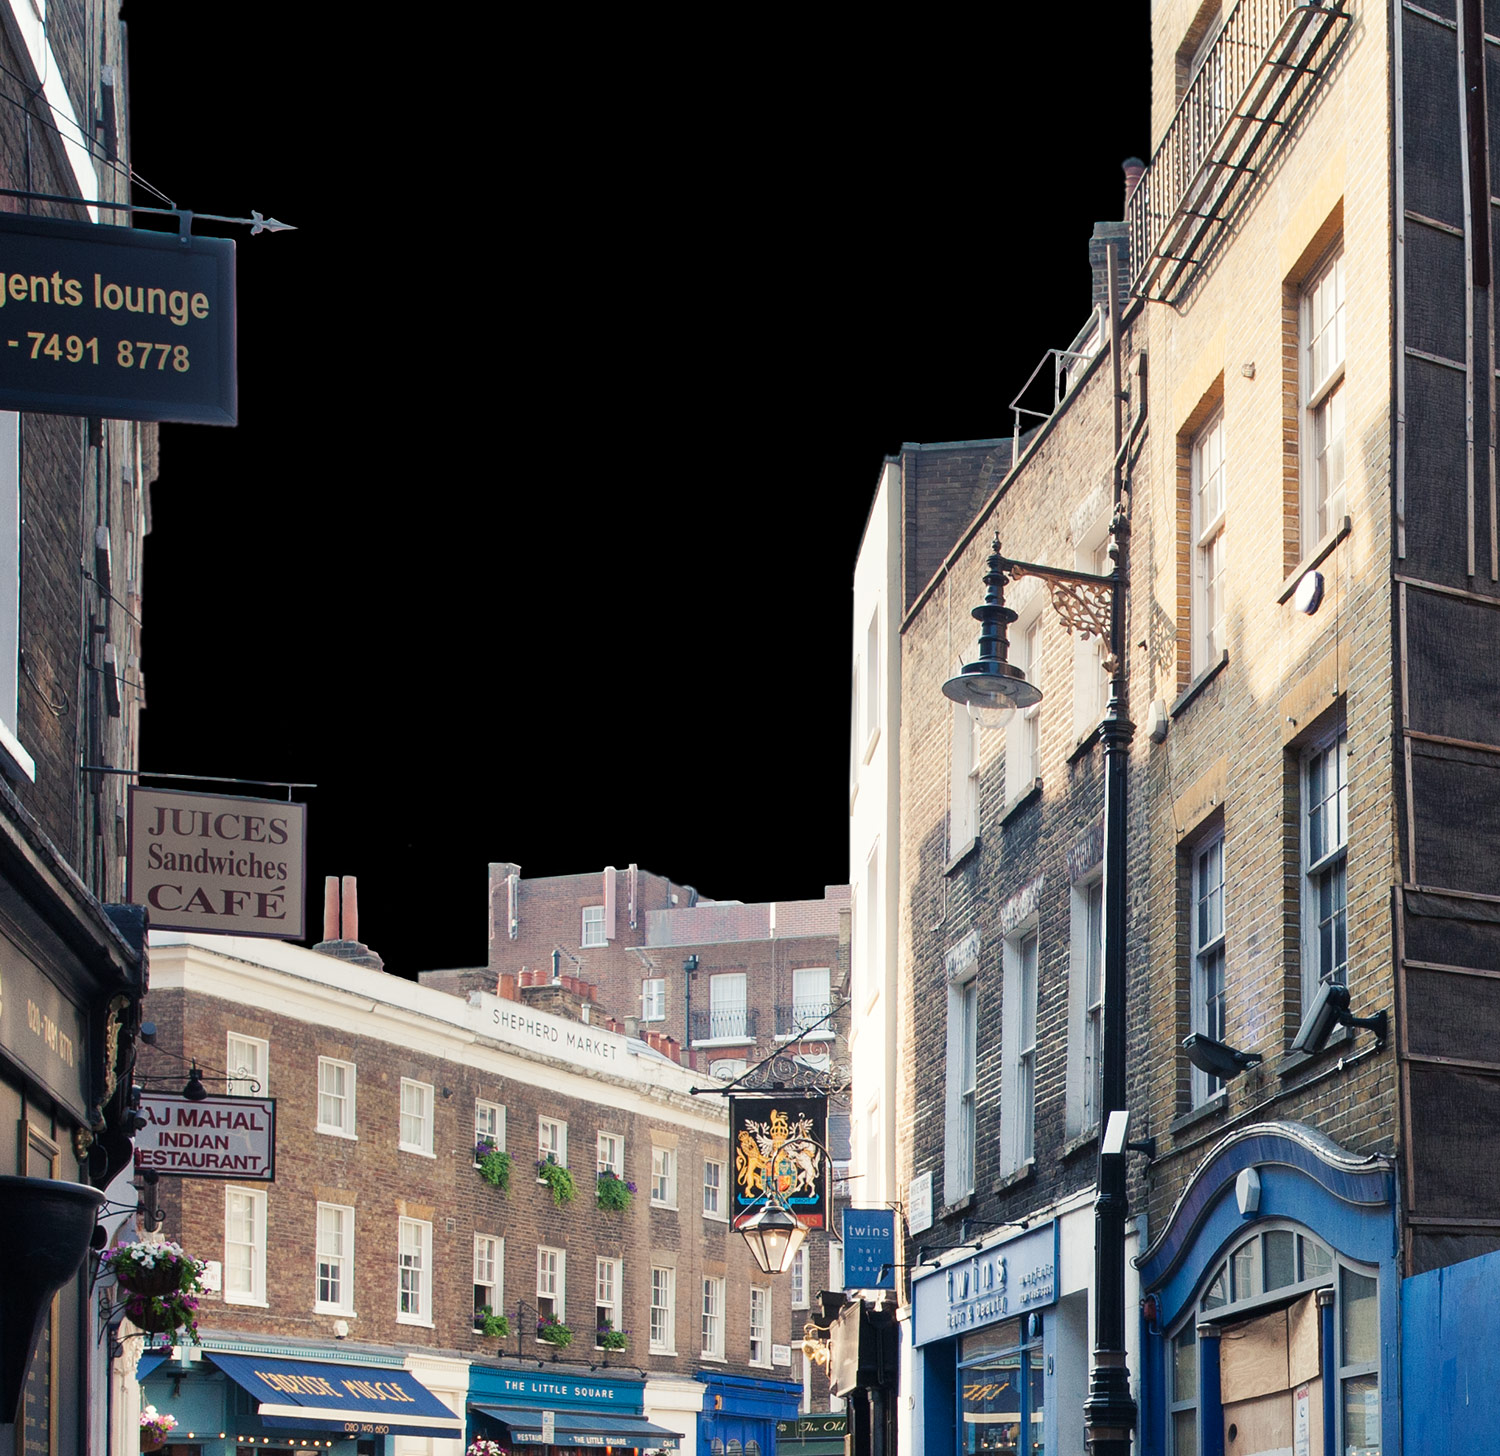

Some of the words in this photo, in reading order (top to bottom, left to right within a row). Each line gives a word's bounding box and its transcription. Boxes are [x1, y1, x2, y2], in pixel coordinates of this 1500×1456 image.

[94, 273, 209, 326] lounge
[27, 331, 99, 365] 7491
[117, 340, 190, 373] 8778
[148, 806, 288, 845] JUICES
[148, 843, 287, 881] Sandwiches
[148, 884, 287, 920] CAFÉ
[492, 1009, 559, 1042] SHEPHERD
[566, 1032, 617, 1060] MARKET
[59, 1030, 73, 1068] 8778
[139, 1106, 171, 1126] AJ
[177, 1108, 264, 1131] MAHAL
[158, 1132, 229, 1150] INDIAN
[140, 1149, 262, 1170] ESTAURANT
[803, 1216, 818, 1225] MS
[849, 1225, 889, 1237] twins
[945, 1254, 1007, 1303] twins
[976, 1295, 1008, 1319] beauty
[340, 1379, 415, 1403] MUSCLE
[505, 1380, 525, 1391] THE
[532, 1383, 568, 1395] LITTLE
[574, 1387, 614, 1399] SQUARE
[344, 1422, 359, 1432] 020
[516, 1433, 543, 1442] RESTAUR
[799, 1421, 819, 1432] The
[823, 1420, 846, 1432] Old
[573, 1435, 585, 1444] THE
[586, 1436, 604, 1445] LITTLE
[606, 1437, 627, 1446] SQUARE
